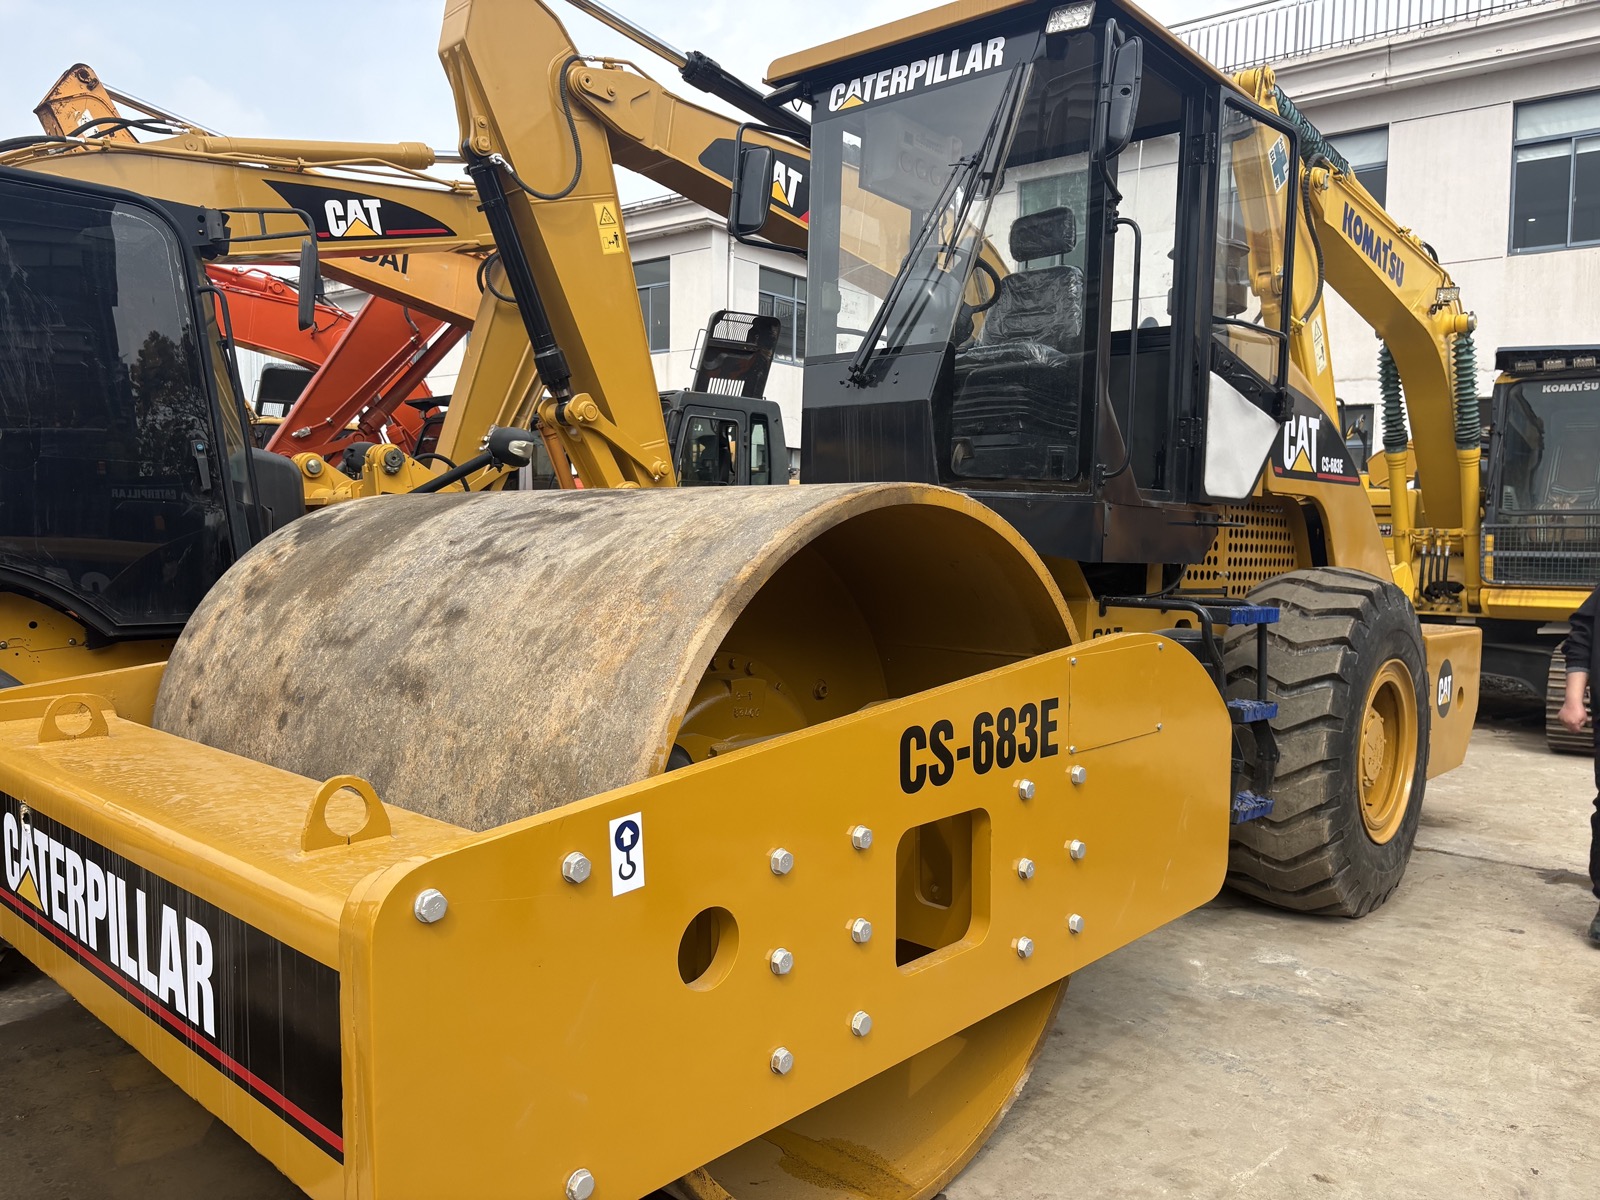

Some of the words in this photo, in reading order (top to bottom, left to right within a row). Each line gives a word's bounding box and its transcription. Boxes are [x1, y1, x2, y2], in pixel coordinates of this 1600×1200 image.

[828, 36, 1006, 112] CATERPILLAR
[773, 160, 803, 208] AT
[324, 199, 382, 237] CAT
[1342, 201, 1405, 288] KOMATSU
[1542, 381, 1600, 393] KOMATSU
[1283, 414, 1320, 473] CAT
[1321, 456, 1344, 474] CS-683E
[1438, 675, 1452, 706] CAT
[900, 697, 1059, 794] CS-683E
[3, 812, 216, 1038] CATERPILLAR
